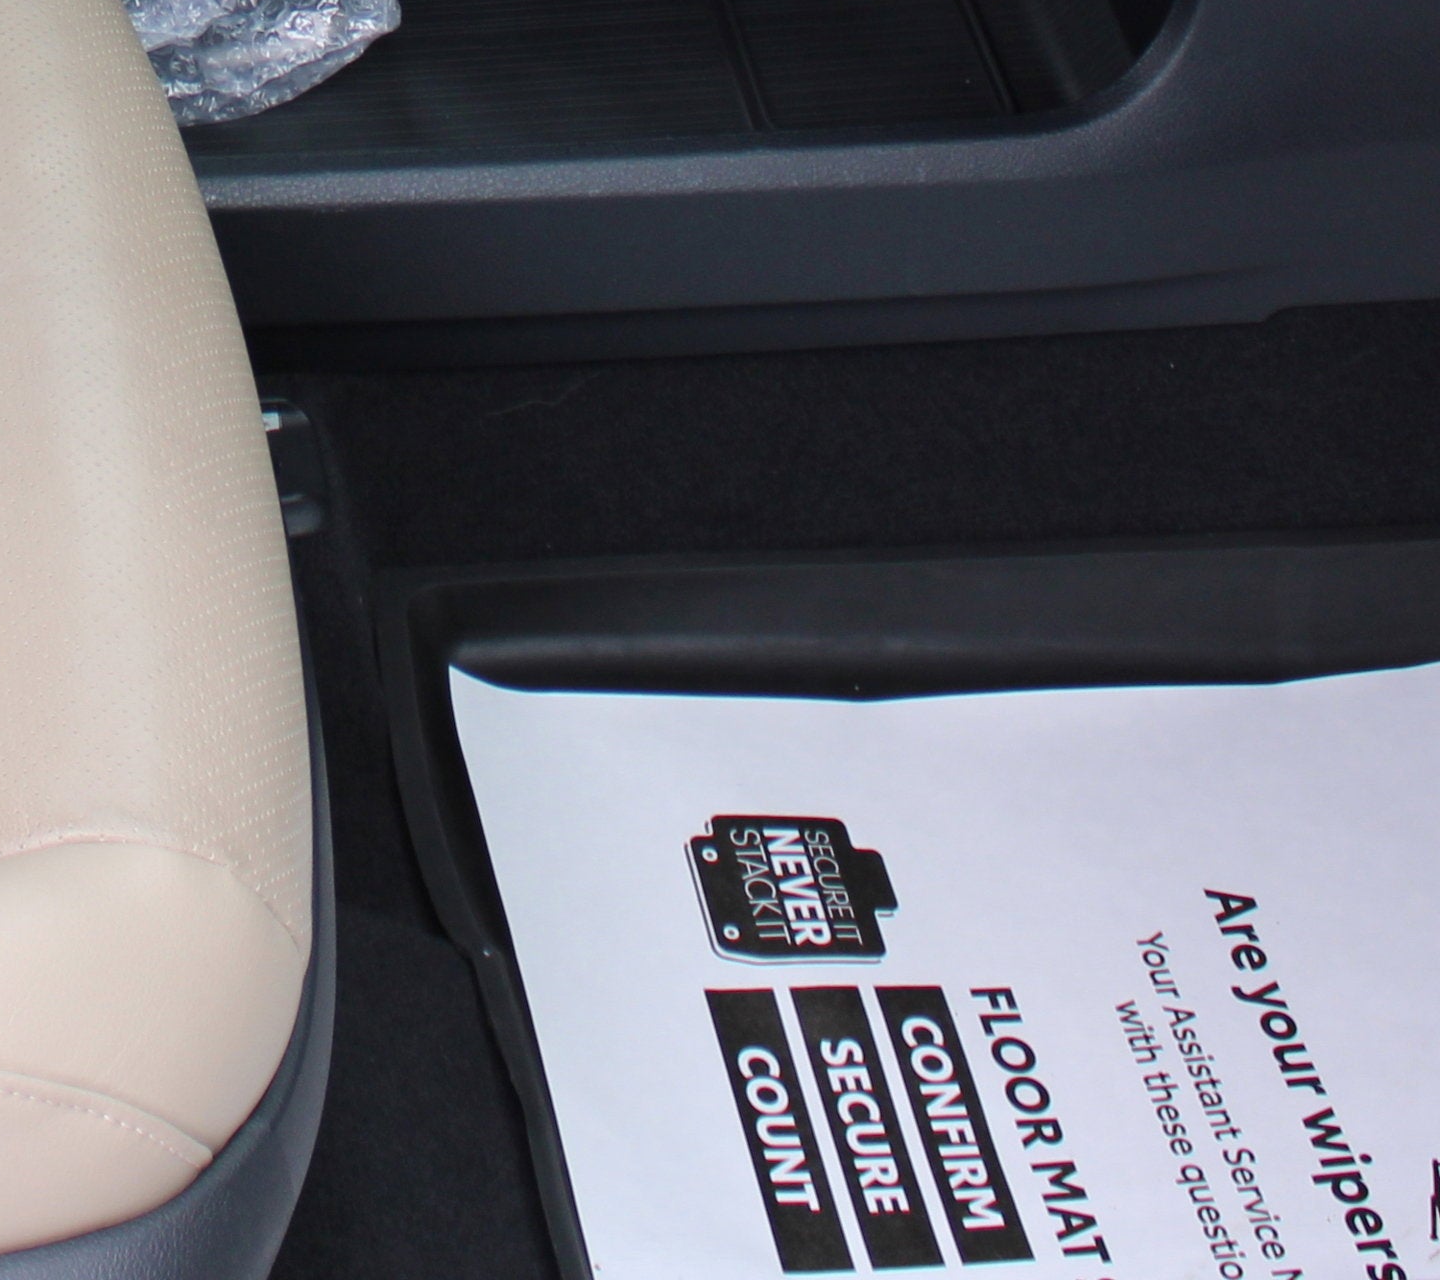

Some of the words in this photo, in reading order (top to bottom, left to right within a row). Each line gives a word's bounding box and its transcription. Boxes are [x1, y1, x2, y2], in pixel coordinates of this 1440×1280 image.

[729, 828, 783, 917] STACK
[755, 921, 791, 946] IT
[762, 827, 831, 946] NEVER
[804, 829, 855, 920] SECURE
[833, 924, 863, 946] IT
[1202, 888, 1268, 972] Are
[1115, 998, 1163, 1064] with
[1141, 1070, 1193, 1157] these
[1136, 931, 1181, 999] Your
[1162, 1004, 1242, 1141] Assistant
[1222, 1147, 1286, 1260] Service
[1230, 980, 1327, 1096] your
[736, 1045, 821, 1216] COUNT
[819, 1037, 911, 1216] SECURE
[900, 1015, 1006, 1232] CONFIRM
[969, 986, 1065, 1149] FLOOR
[1030, 1159, 1113, 1265] MAT
[1301, 1106, 1408, 1280] wipers
